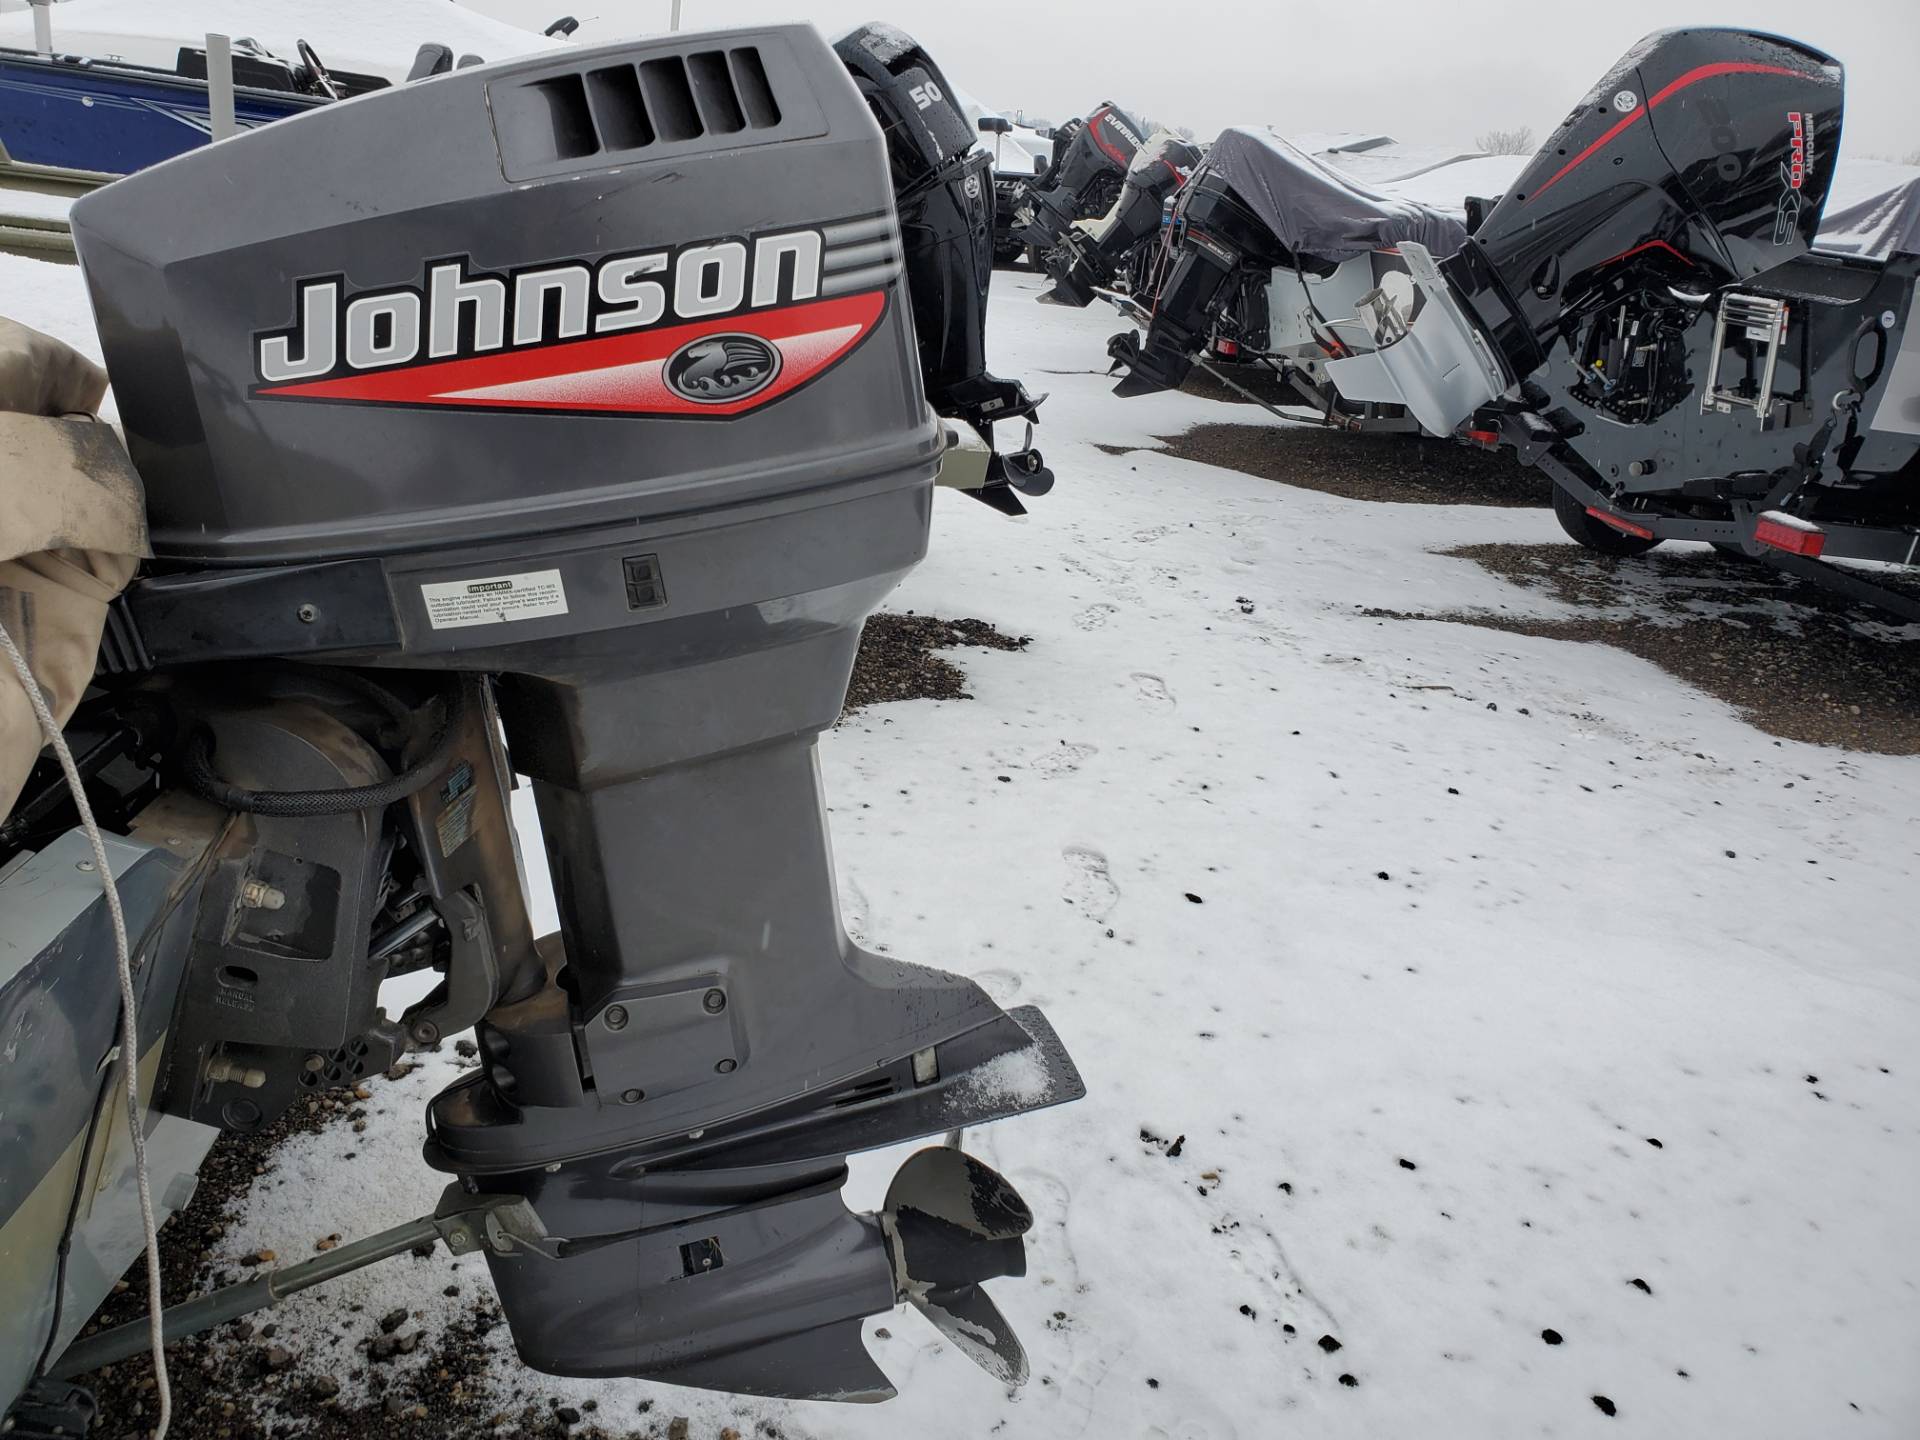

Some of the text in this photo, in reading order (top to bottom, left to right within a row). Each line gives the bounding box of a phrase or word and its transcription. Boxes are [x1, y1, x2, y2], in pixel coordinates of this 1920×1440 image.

[909, 81, 942, 111] 50
[1804, 112, 1815, 175] MERCURY
[1773, 112, 1804, 246] PRO XS
[260, 230, 822, 382] Johnson
[468, 581, 512, 593] Important
